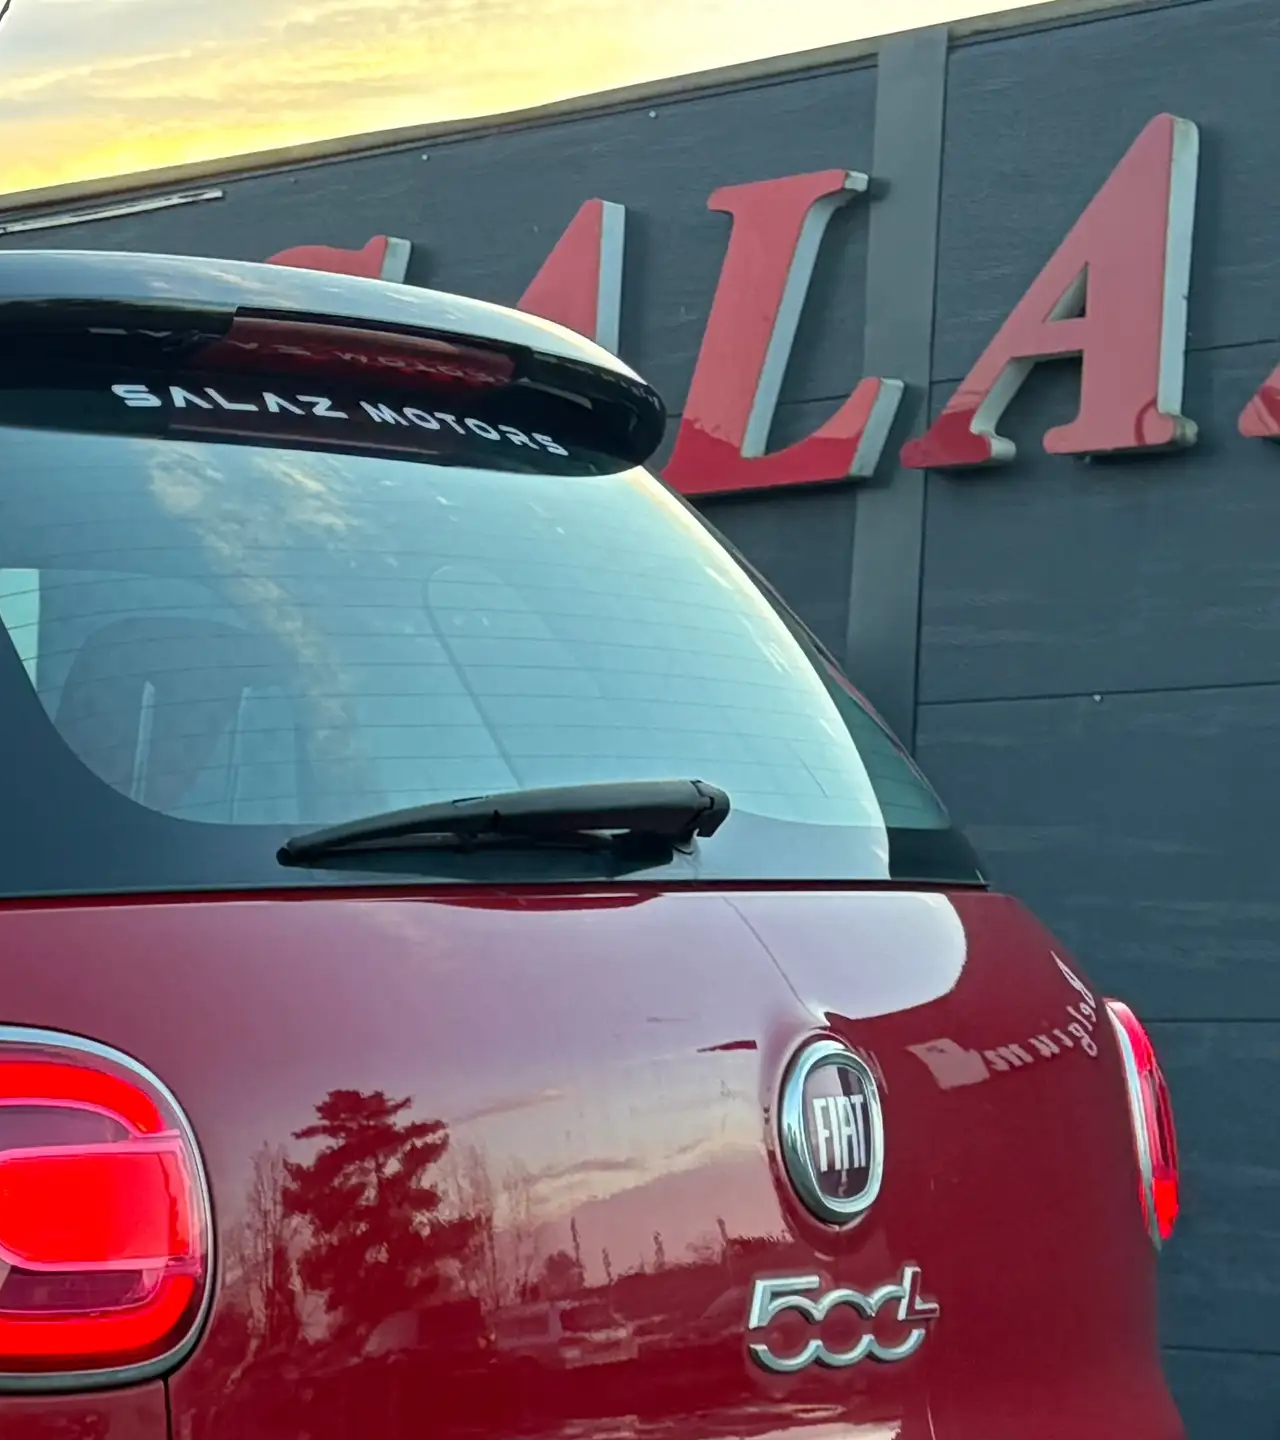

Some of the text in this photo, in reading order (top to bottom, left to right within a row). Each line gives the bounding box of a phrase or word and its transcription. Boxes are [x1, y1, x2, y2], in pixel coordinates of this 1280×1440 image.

[111, 383, 570, 457] SALAZ MOTORS
[812, 1093, 867, 1174] FIAT
